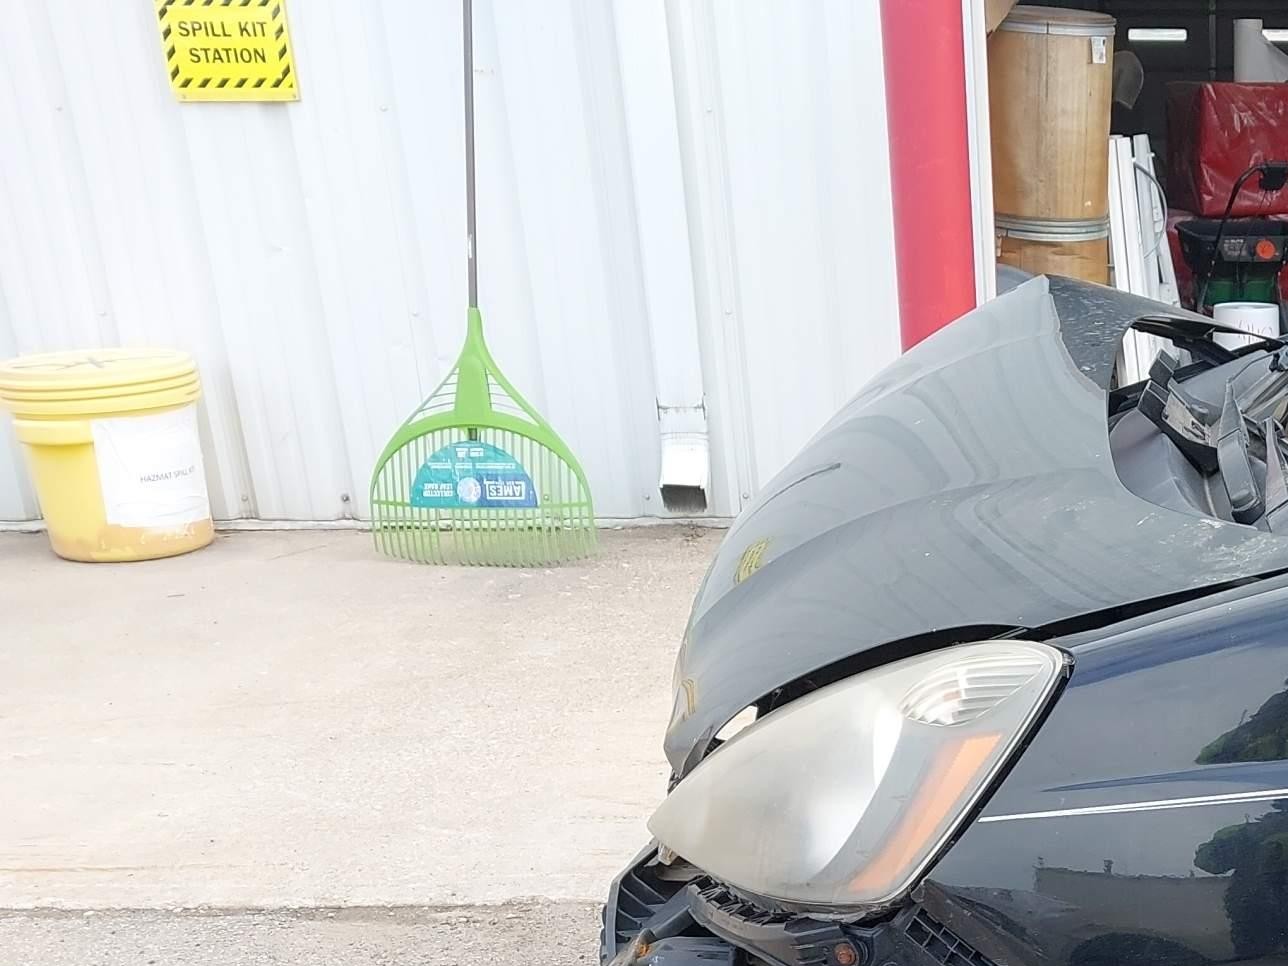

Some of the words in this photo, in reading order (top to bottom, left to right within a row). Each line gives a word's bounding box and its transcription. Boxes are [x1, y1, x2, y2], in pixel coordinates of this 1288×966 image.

[178, 21, 232, 37] SPILL
[238, 21, 267, 37] KIT
[189, 47, 267, 63] STATION
[140, 471, 172, 484] HAZMAT
[489, 485, 521, 497] AMES
